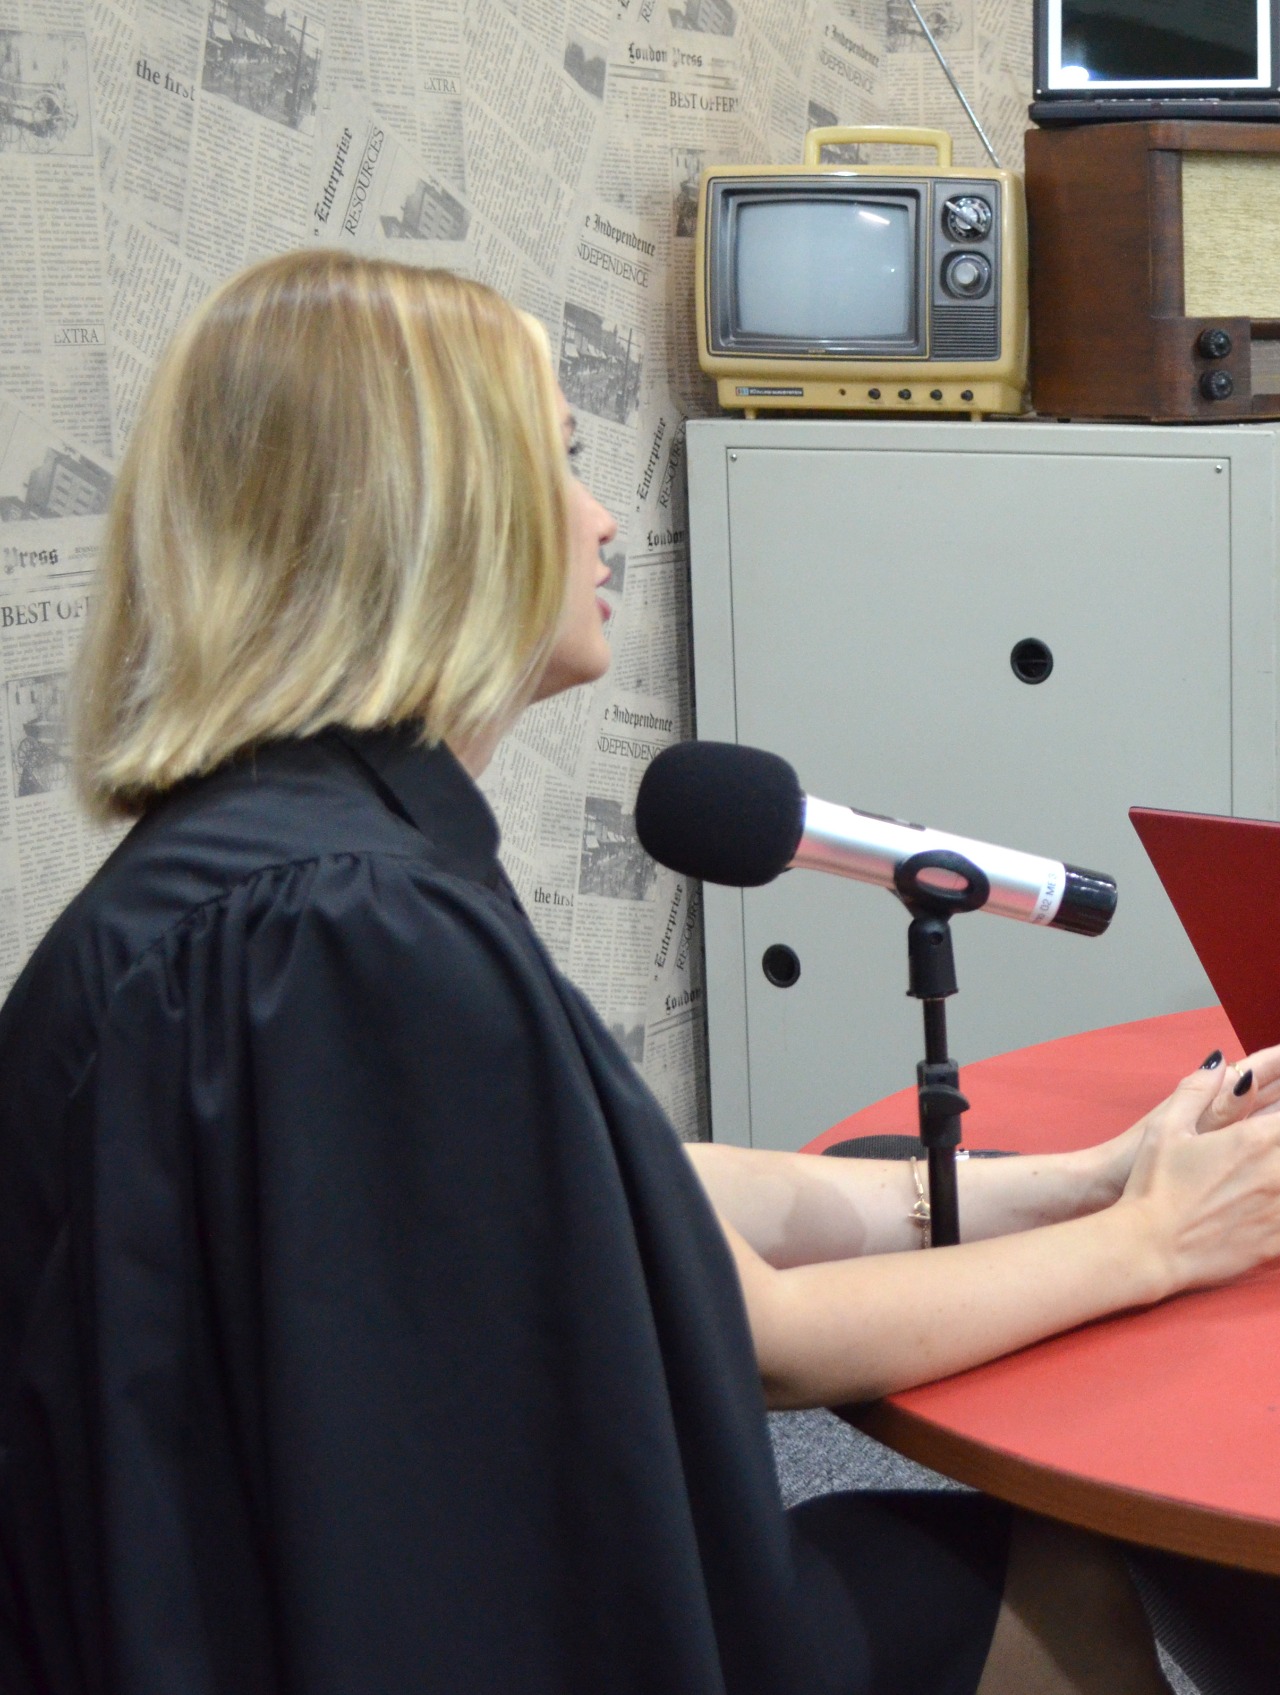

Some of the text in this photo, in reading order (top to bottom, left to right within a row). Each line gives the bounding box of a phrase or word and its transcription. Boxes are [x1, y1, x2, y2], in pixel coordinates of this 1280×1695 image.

[629, 42, 667, 64] London
[136, 59, 161, 85] the
[669, 92, 697, 110] BEST
[344, 127, 385, 236] RESOURCES
[593, 214, 657, 257] Independence
[54, 327, 100, 344] EXTRA
[1, 601, 51, 628] BEST
[613, 704, 674, 732] Independence
[534, 887, 551, 904] the
